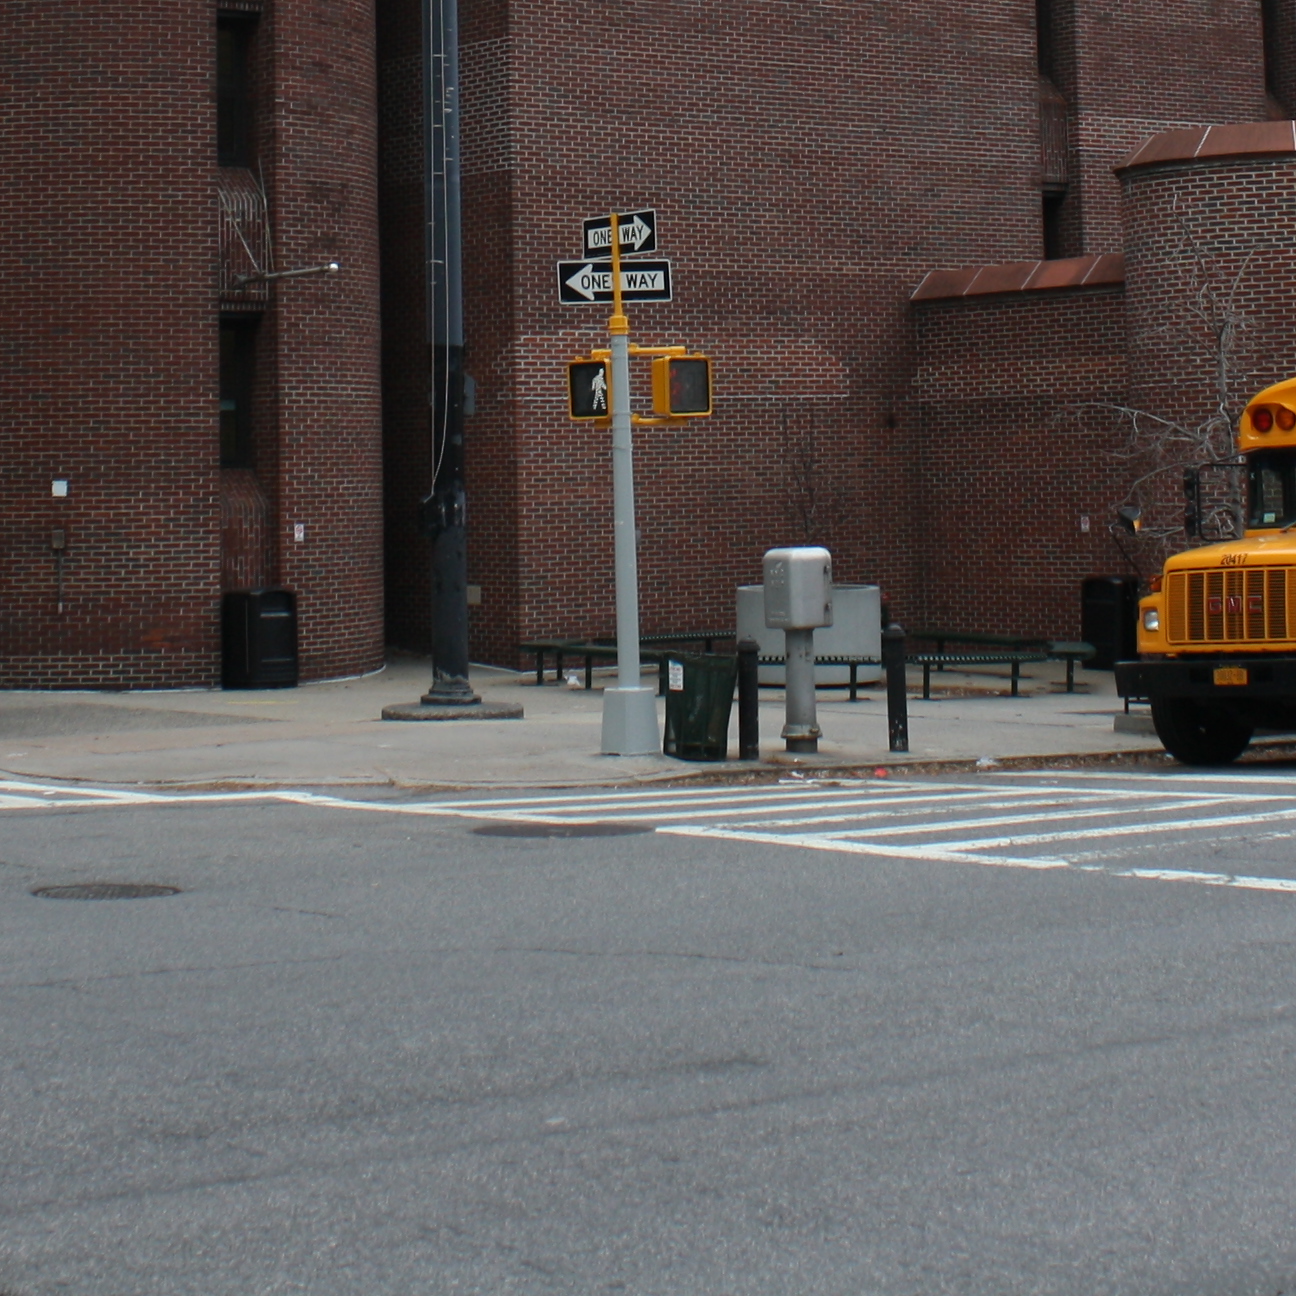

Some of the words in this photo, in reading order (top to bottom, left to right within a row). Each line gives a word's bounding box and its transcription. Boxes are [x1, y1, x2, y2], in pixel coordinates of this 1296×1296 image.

[593, 228, 612, 247] ONE
[622, 225, 644, 242] WAY
[581, 274, 611, 290] ONE
[626, 273, 658, 289] WAY
[1220, 553, 1248, 564] 20417
[1208, 595, 1262, 615] GMC
